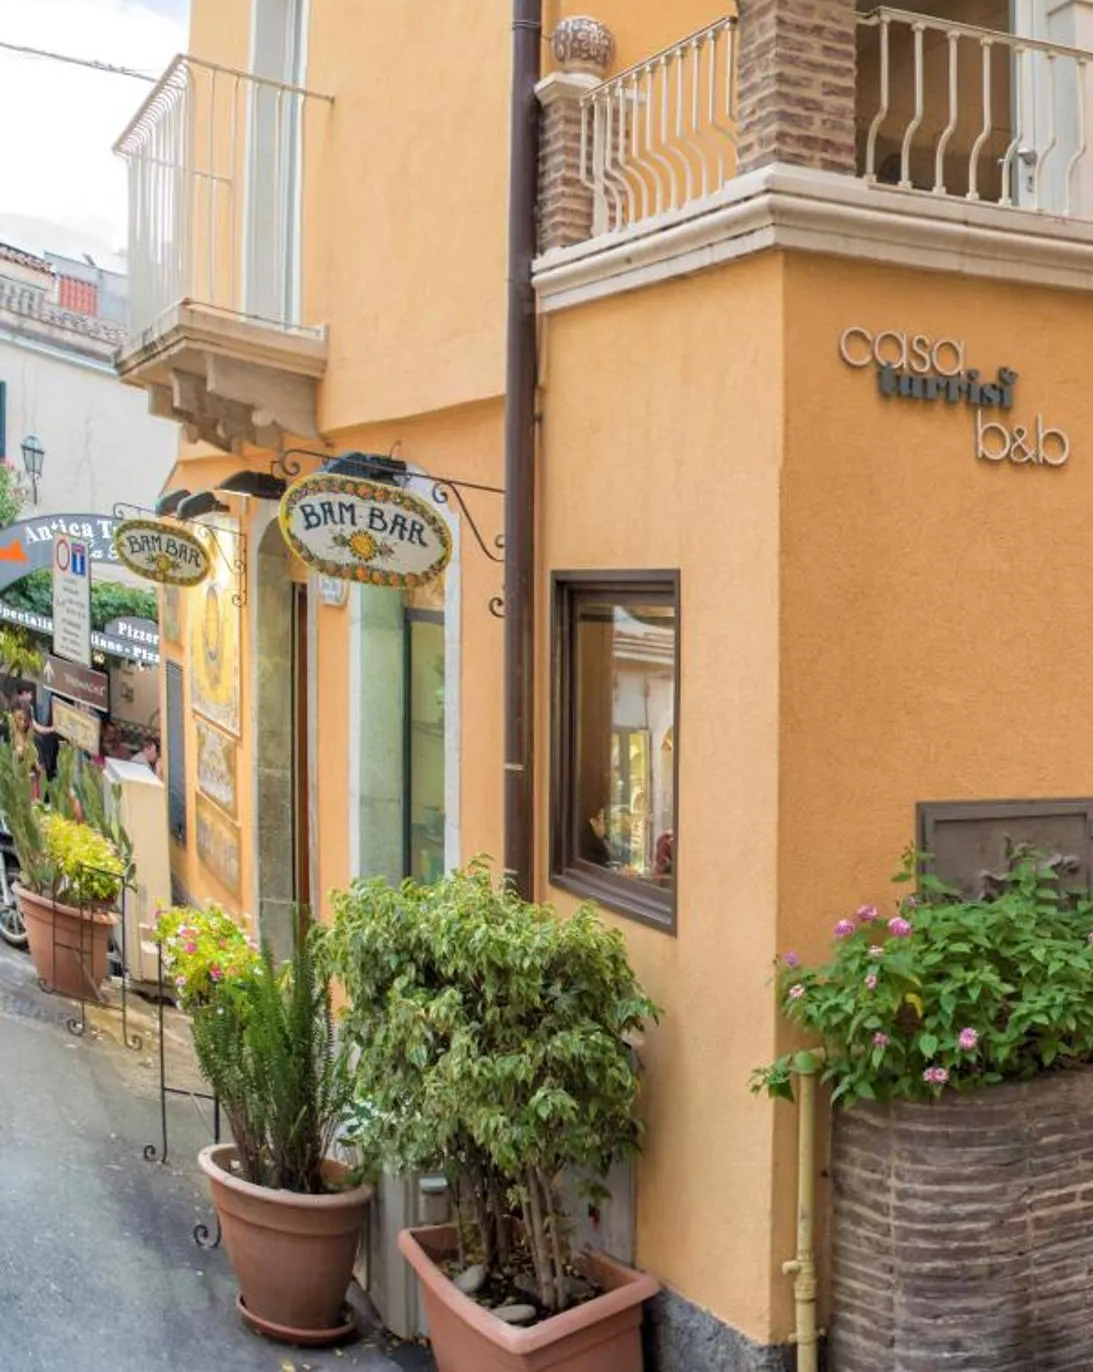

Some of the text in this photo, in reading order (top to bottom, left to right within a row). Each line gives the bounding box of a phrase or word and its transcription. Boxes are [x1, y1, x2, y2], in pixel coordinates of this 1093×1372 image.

[839, 326, 966, 377] casa
[876, 361, 1018, 410] turrisi
[975, 409, 1071, 467] b&b
[25, 518, 93, 545] Antica
[300, 501, 428, 548] BAM BAR
[126, 535, 162, 555] BAM
[165, 536, 202, 568] BAR
[118, 621, 160, 645] Pizzer
